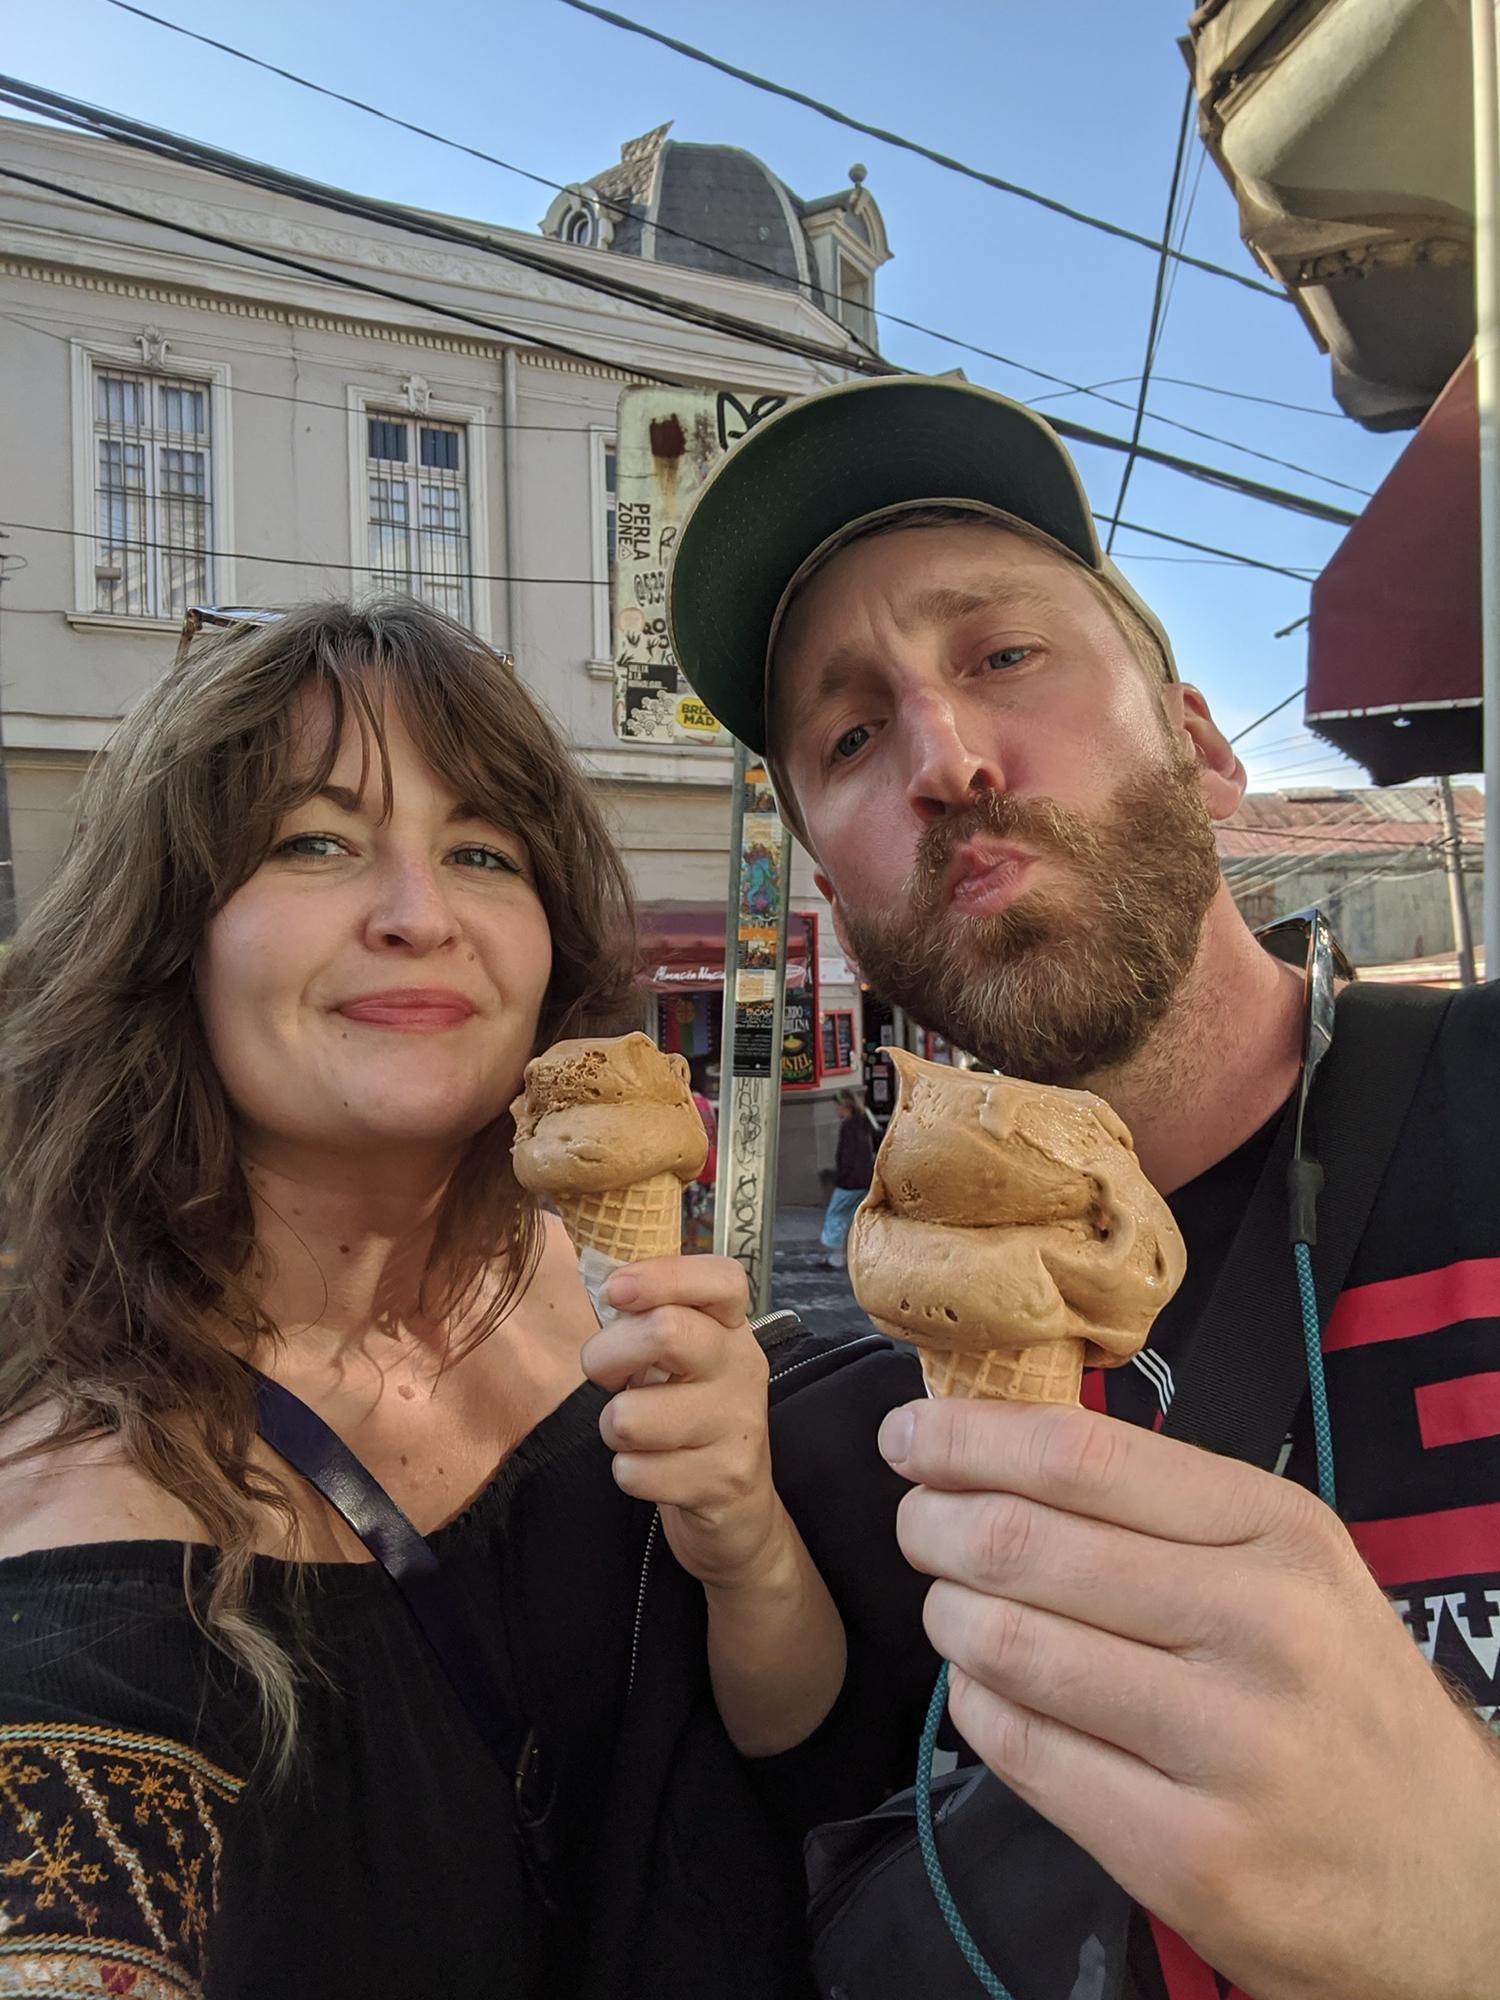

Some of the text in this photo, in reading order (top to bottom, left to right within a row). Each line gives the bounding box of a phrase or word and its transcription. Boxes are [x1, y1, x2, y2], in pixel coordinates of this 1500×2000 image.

[618, 502, 633, 545] ZONE
[633, 503, 650, 561] PERLA
[683, 714, 715, 727] MAD
